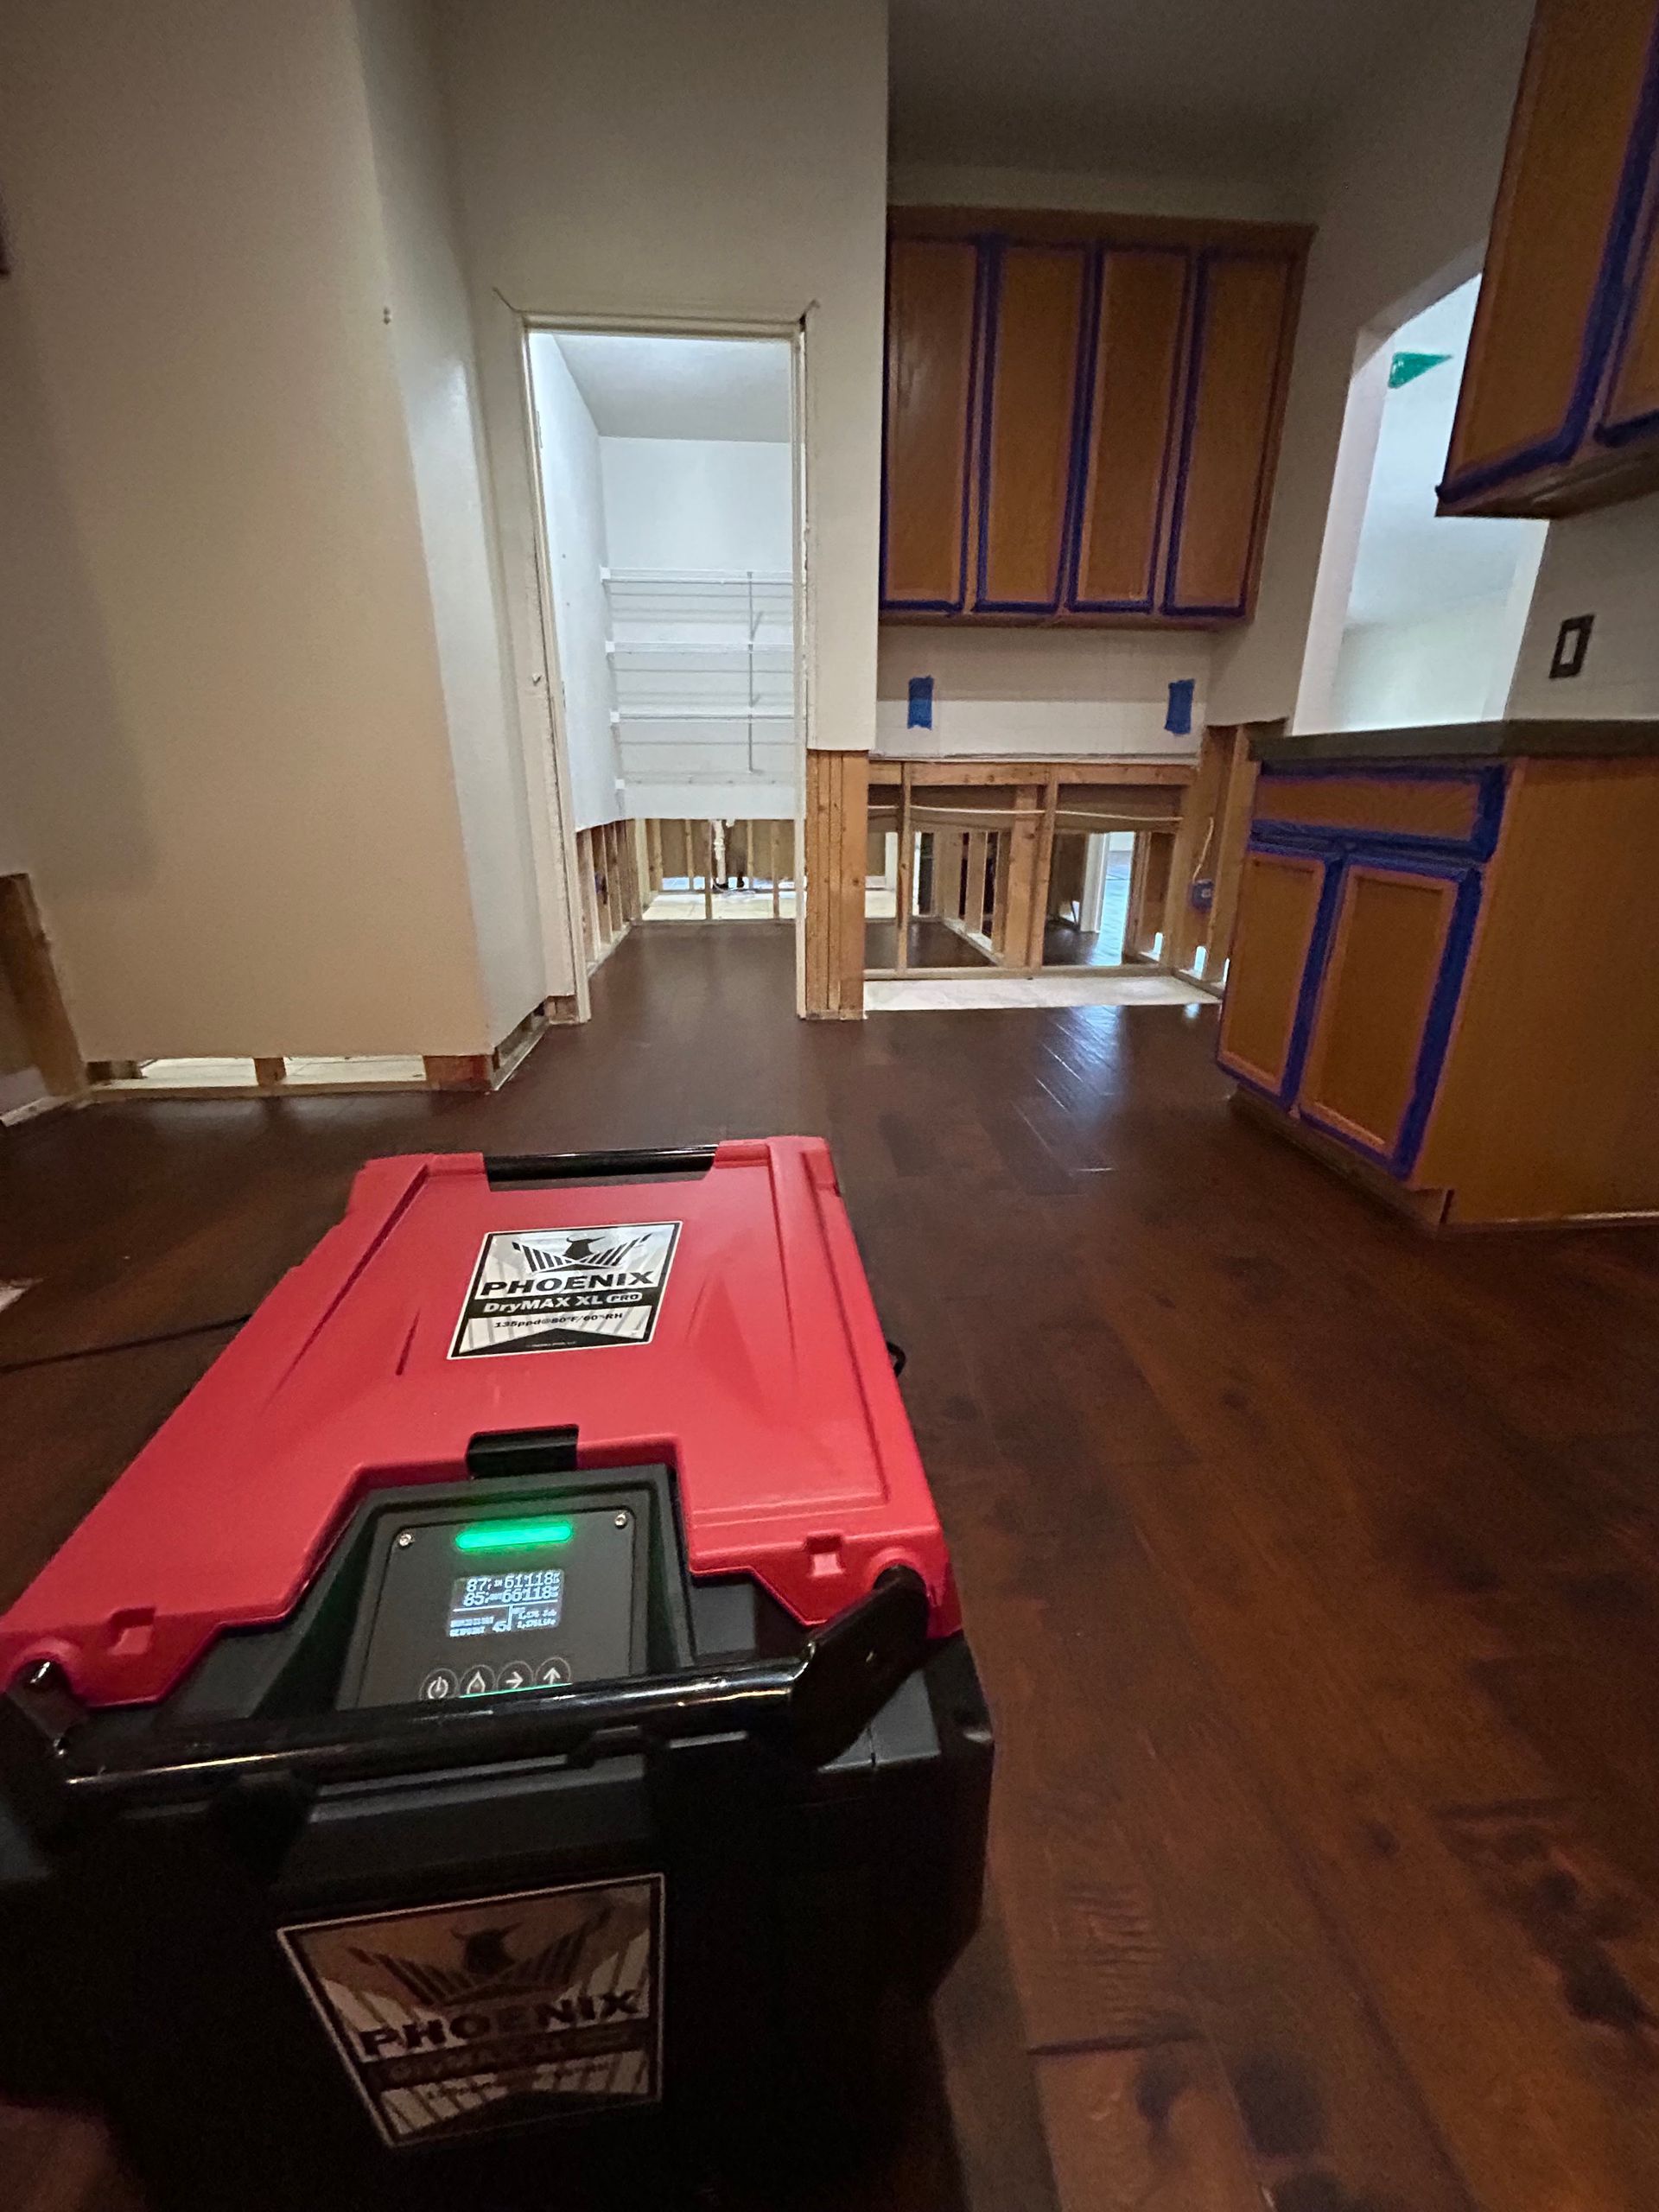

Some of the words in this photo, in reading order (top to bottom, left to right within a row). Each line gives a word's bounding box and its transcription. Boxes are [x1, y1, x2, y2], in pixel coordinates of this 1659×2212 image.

[480, 1271, 653, 1295] PHOENIX
[483, 1297, 570, 1313] DryMAX
[575, 1295, 603, 1306] XL
[610, 1294, 639, 1302] PRO
[359, 1990, 639, 2055] PHOENIX
